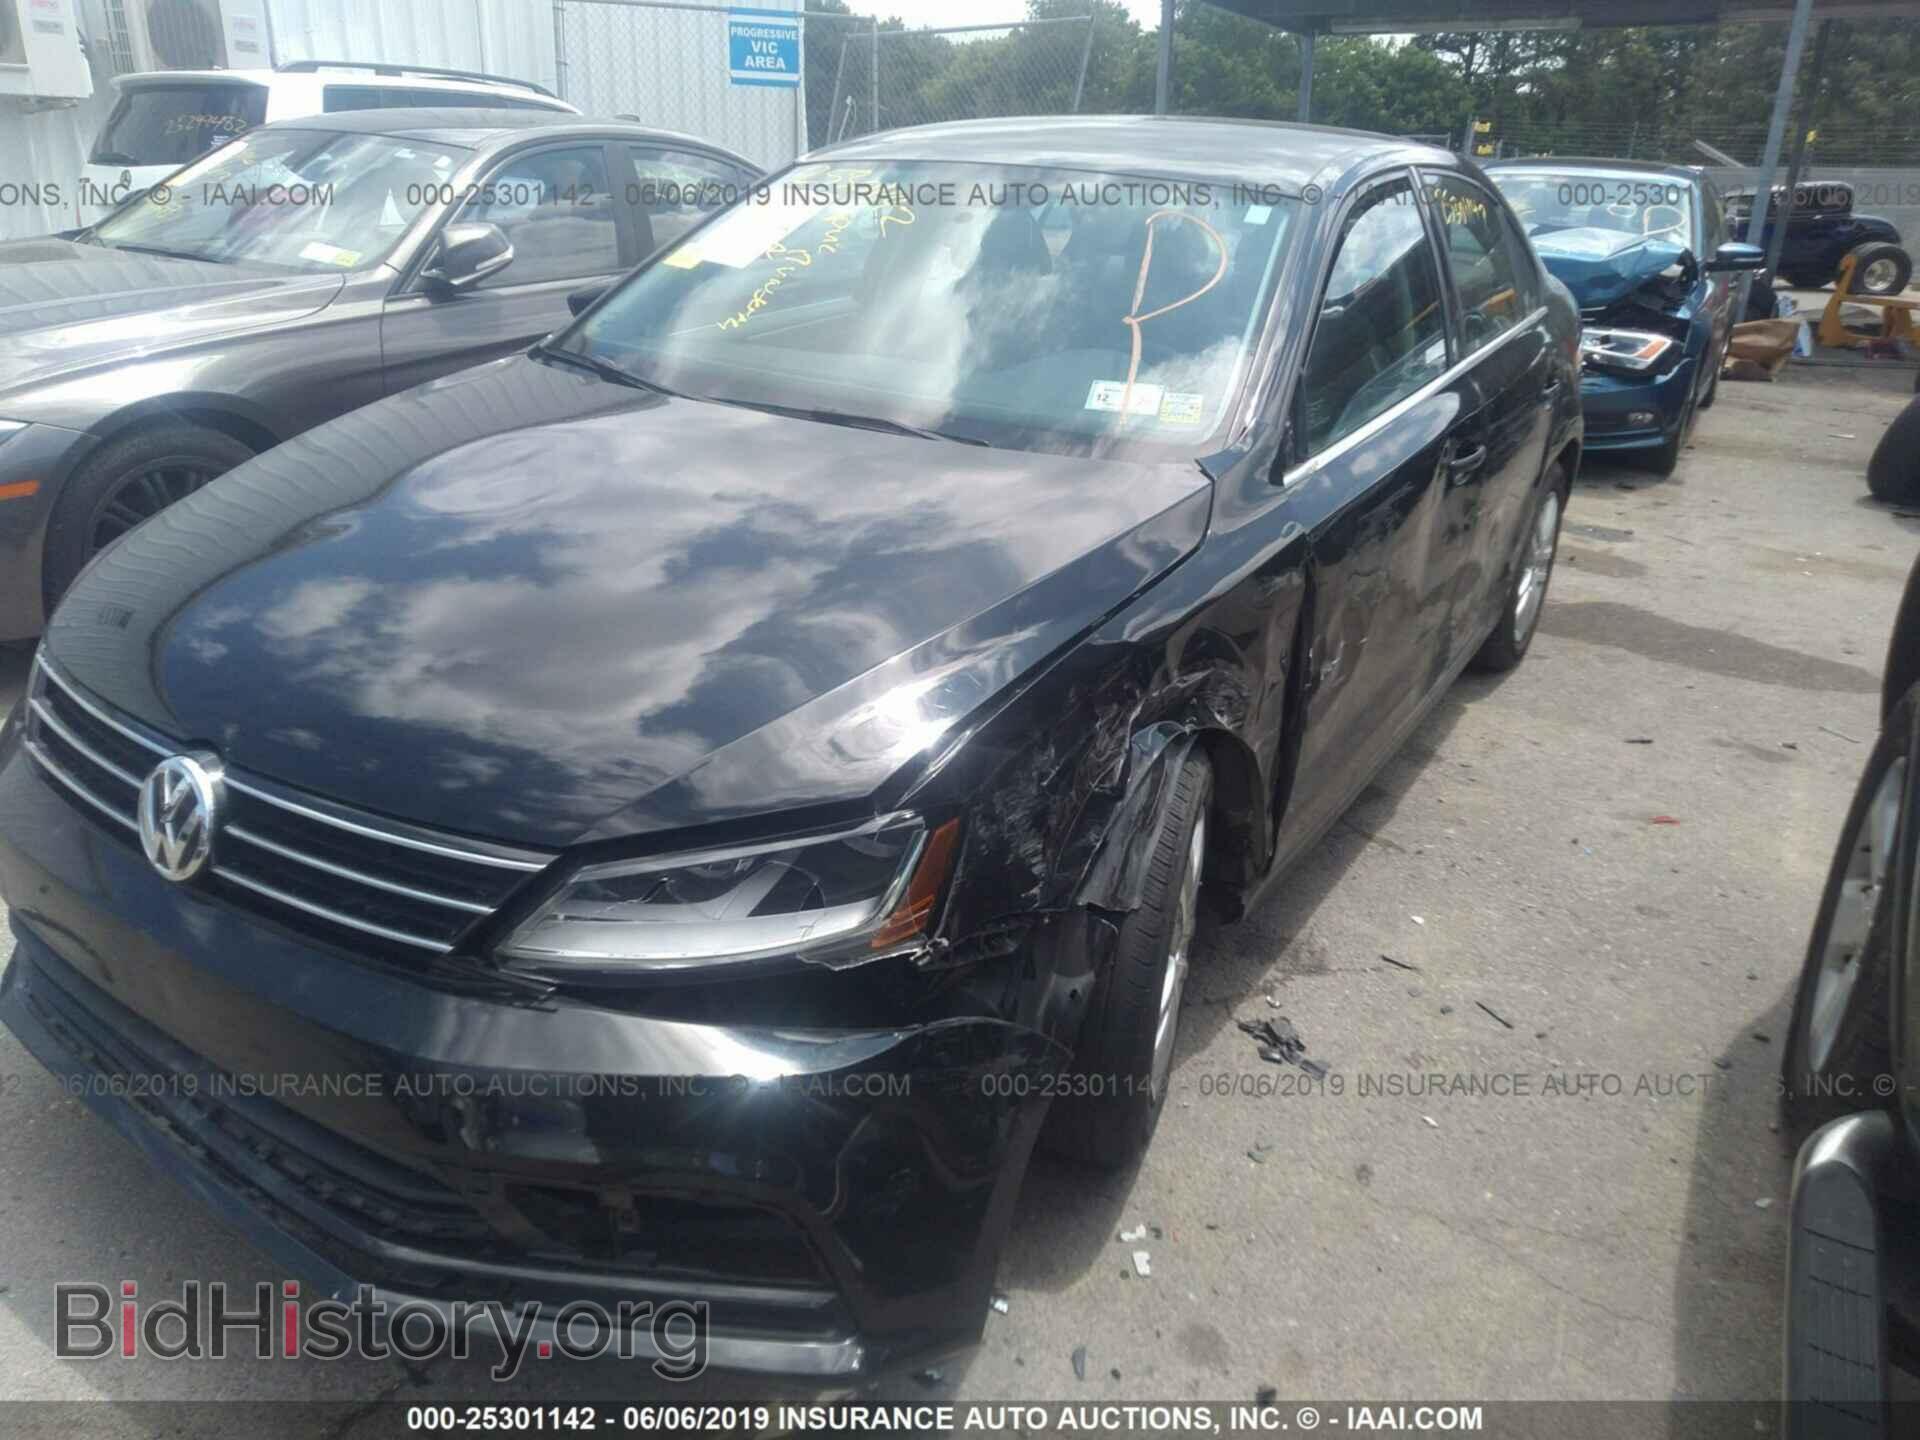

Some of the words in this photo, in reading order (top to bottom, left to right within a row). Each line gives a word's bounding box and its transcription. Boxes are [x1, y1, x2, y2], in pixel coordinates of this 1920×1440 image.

[731, 26, 799, 40] PROGRESSIVE
[751, 40, 778, 54] VIC
[744, 55, 786, 71] AREA
